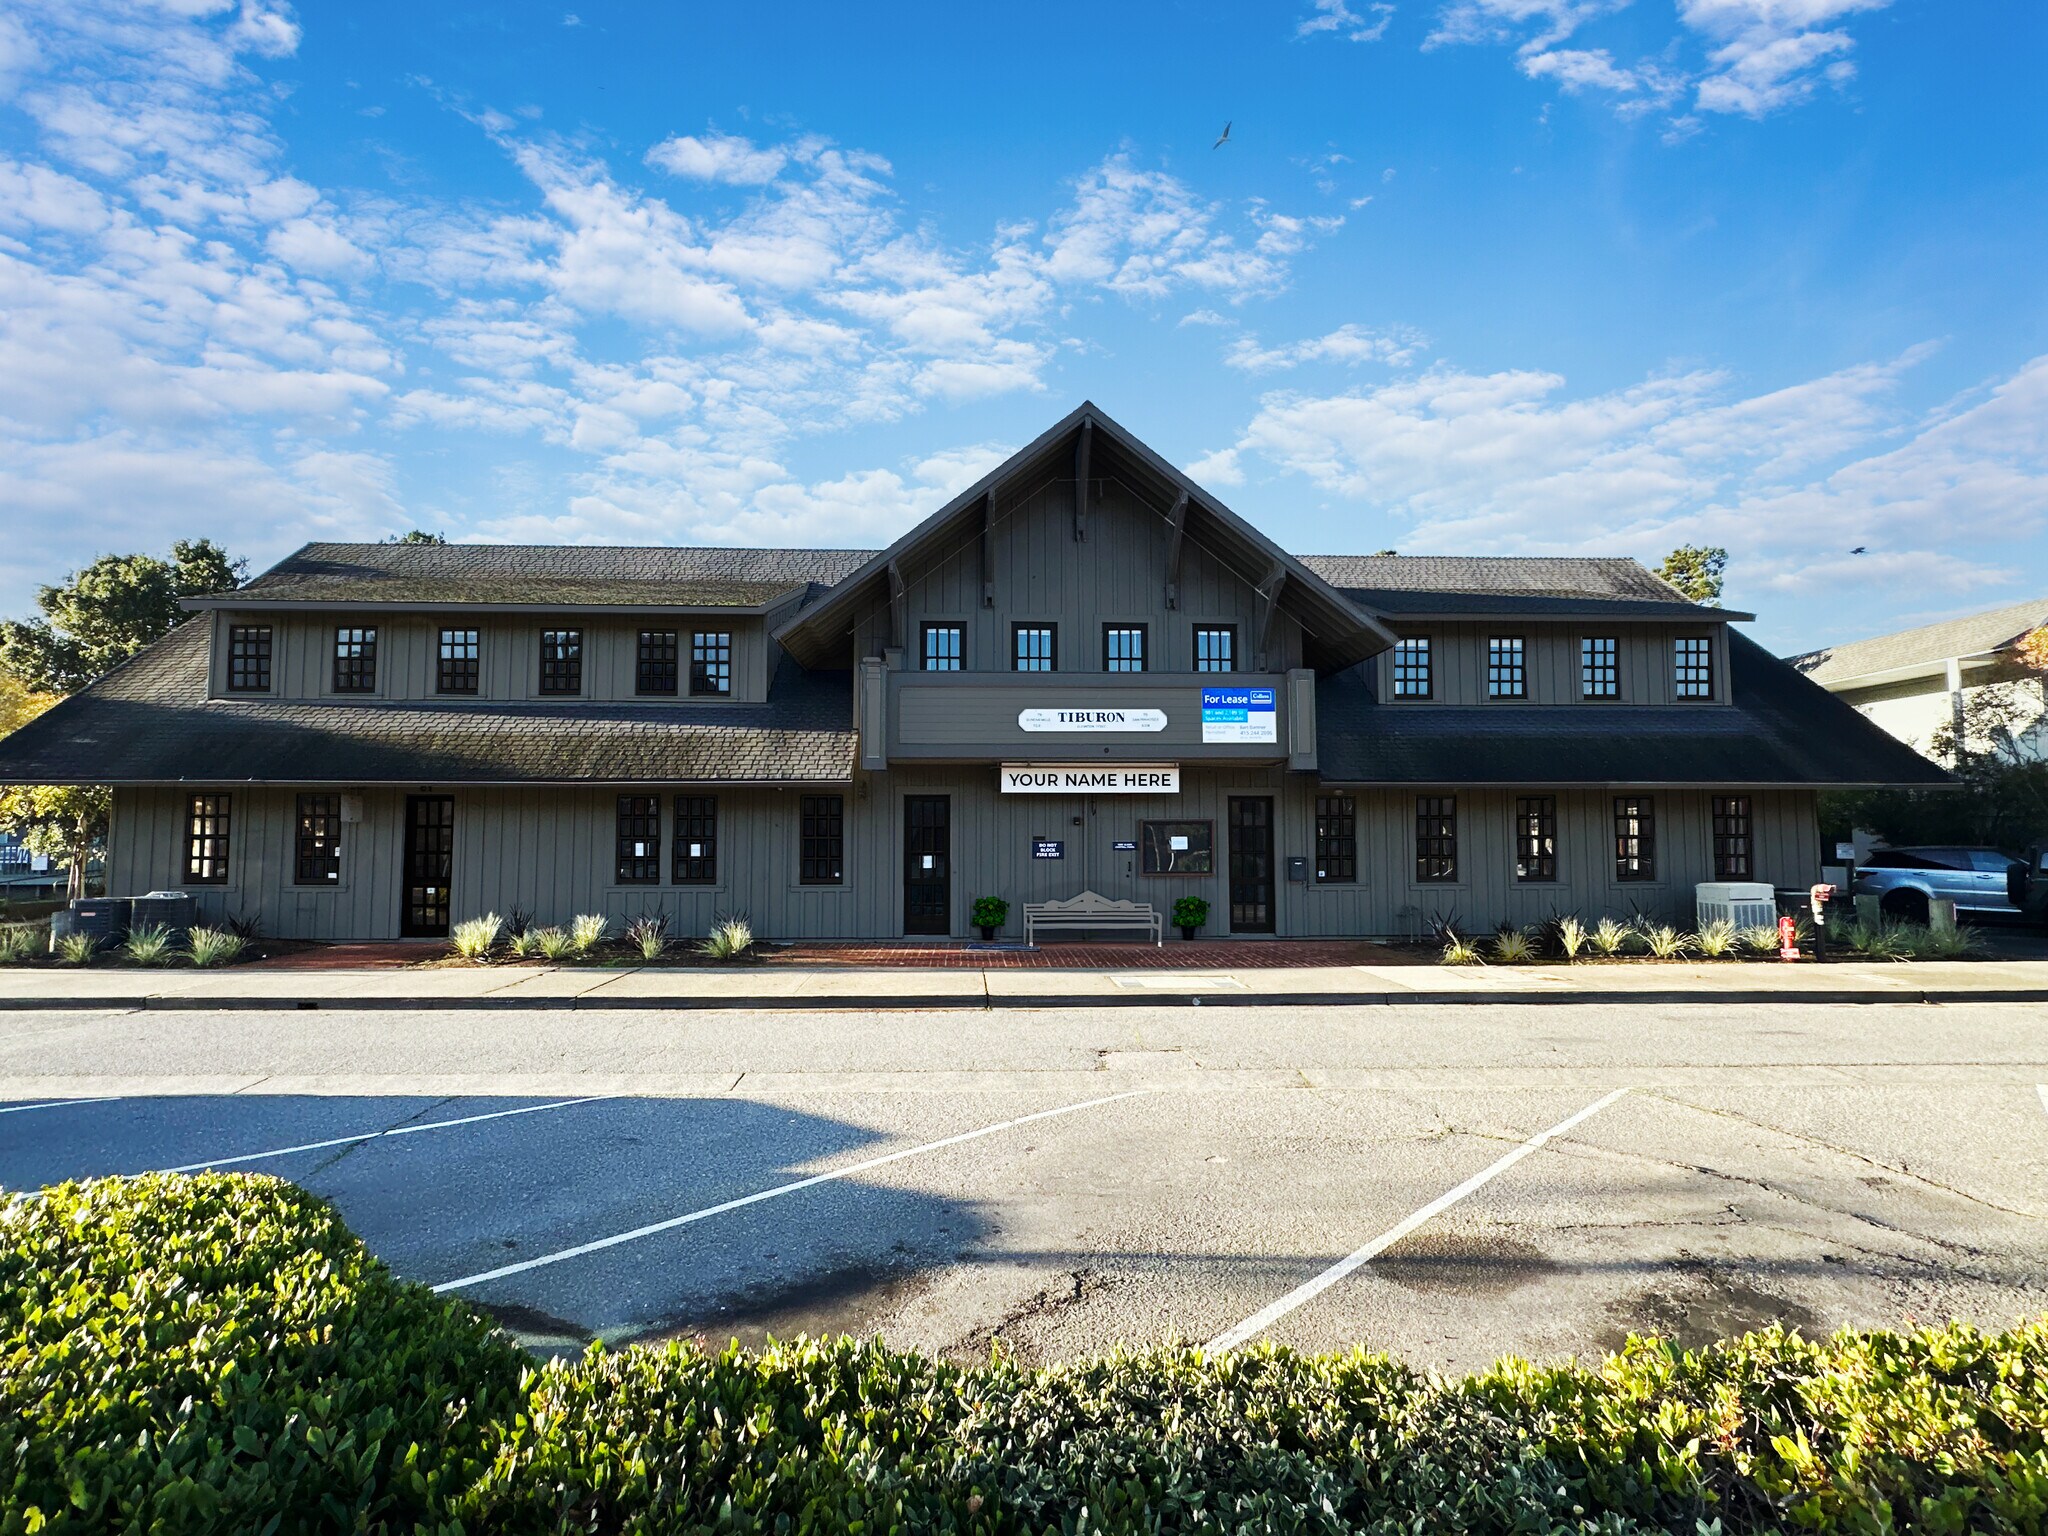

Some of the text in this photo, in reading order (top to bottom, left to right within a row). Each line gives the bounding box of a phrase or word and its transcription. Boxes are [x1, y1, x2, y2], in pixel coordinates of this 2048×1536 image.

[1204, 695, 1248, 704] For Lease
[1057, 712, 1125, 723] TIBURON
[1009, 773, 1172, 787] YOUR NAME HERE
